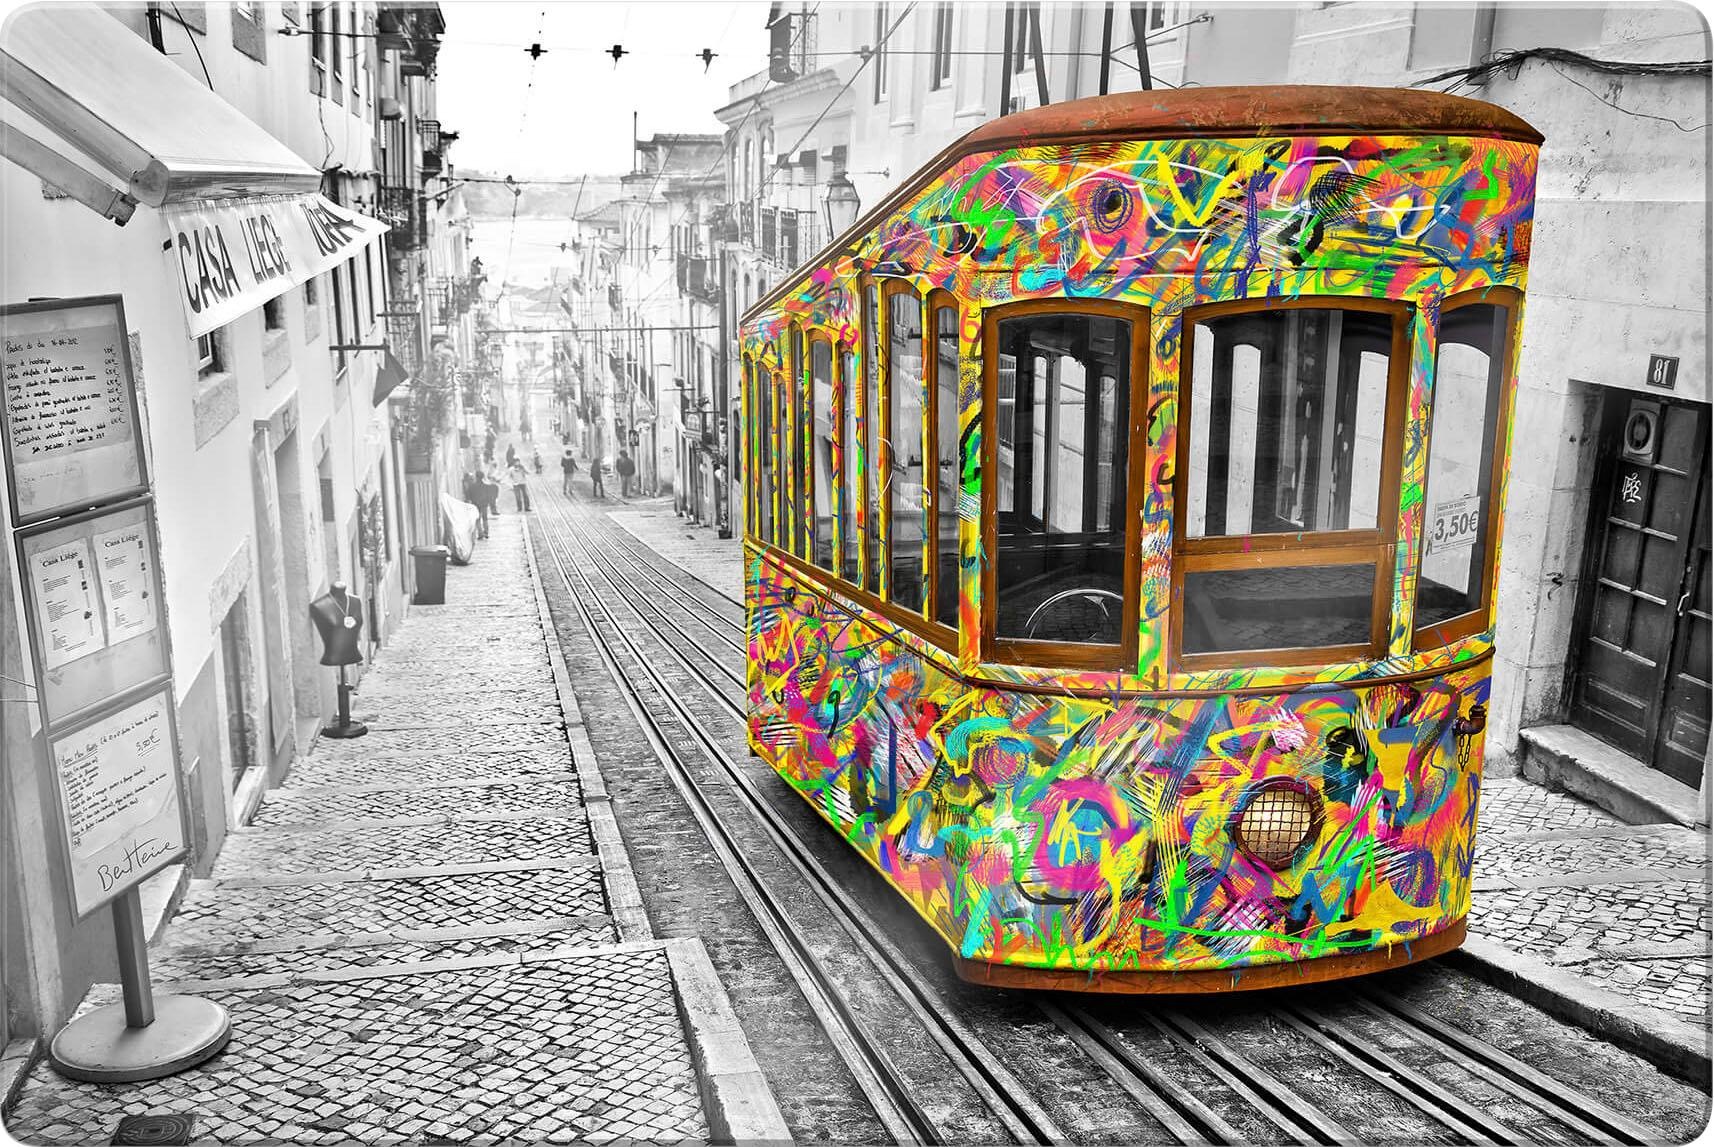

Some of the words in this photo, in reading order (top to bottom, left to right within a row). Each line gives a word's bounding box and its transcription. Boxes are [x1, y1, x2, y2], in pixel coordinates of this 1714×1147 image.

[178, 224, 241, 314] CASA
[1653, 358, 1671, 385] 81
[1434, 509, 1479, 543] 3,50€
